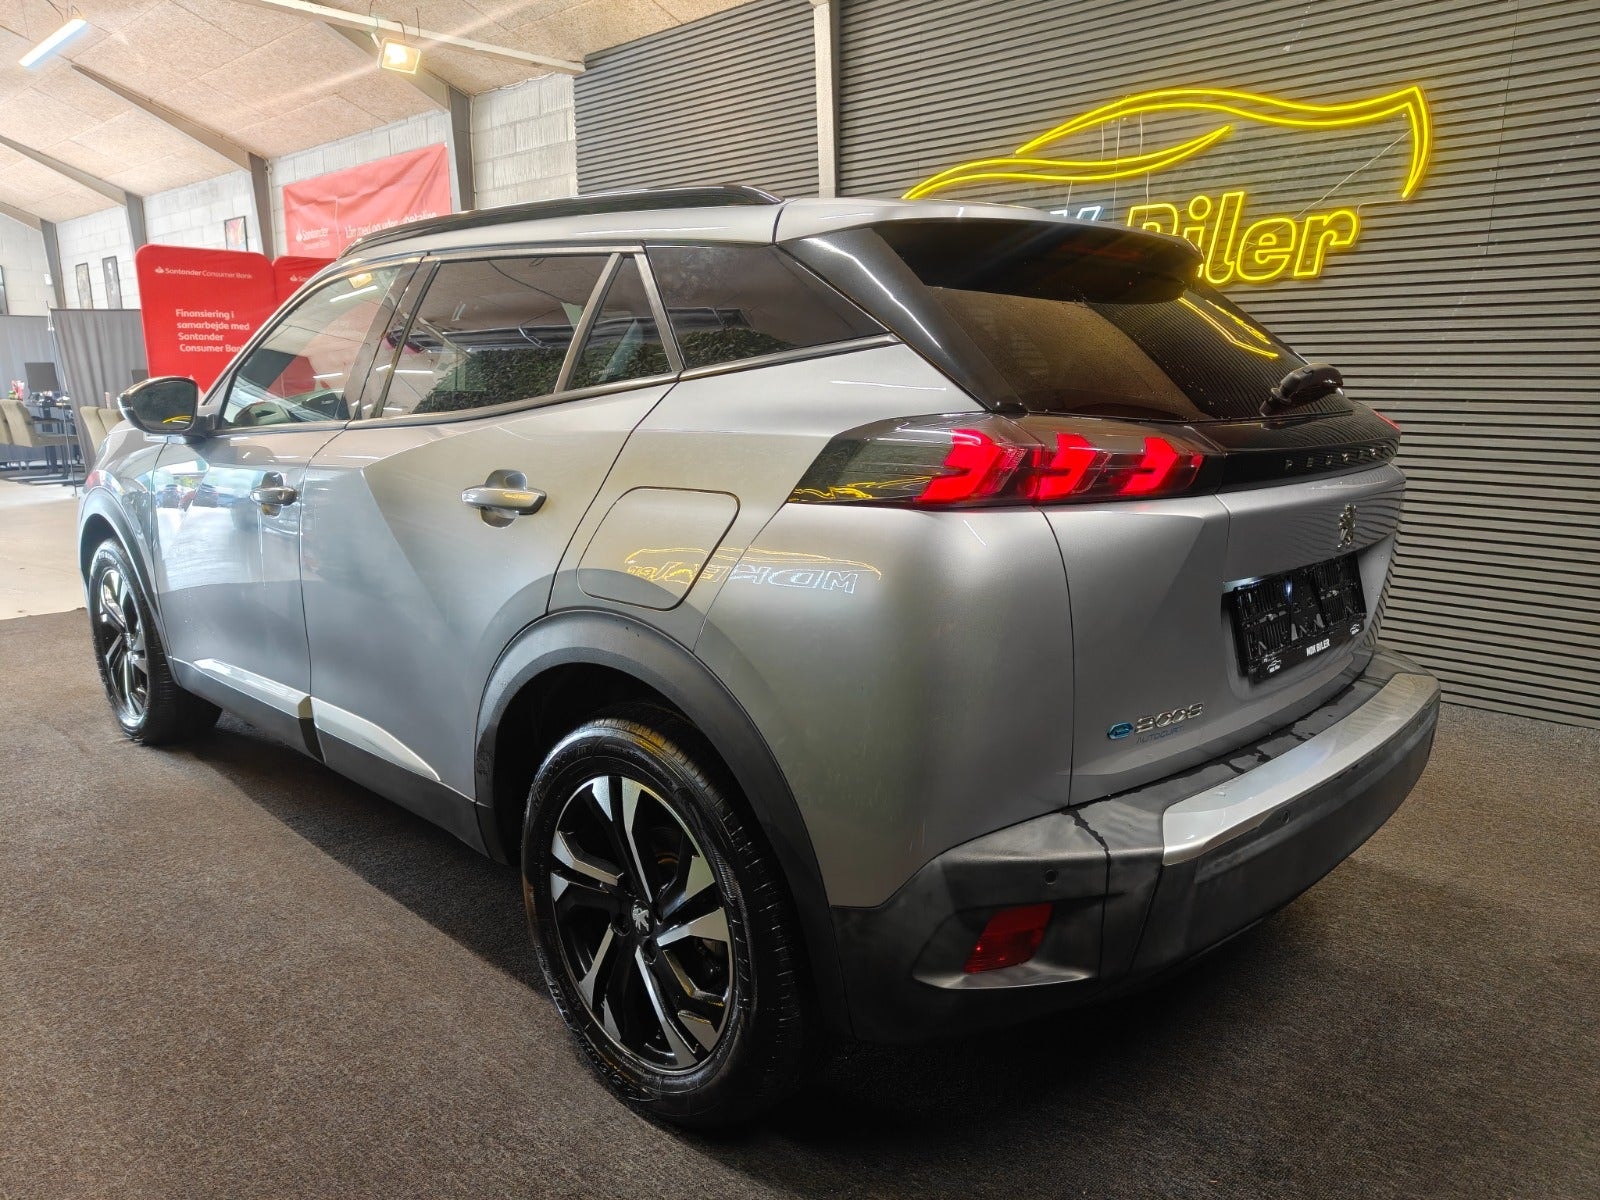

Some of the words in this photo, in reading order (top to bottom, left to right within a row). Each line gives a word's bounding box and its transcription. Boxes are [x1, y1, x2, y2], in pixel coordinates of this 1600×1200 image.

[164, 267, 201, 276] Santander
[201, 269, 235, 278] Consumer
[175, 308, 230, 320] Finansiering
[231, 310, 235, 319] i
[176, 321, 230, 331] samarbejde
[230, 323, 250, 331] med
[177, 332, 224, 341] Santander
[179, 343, 224, 353] Consumer
